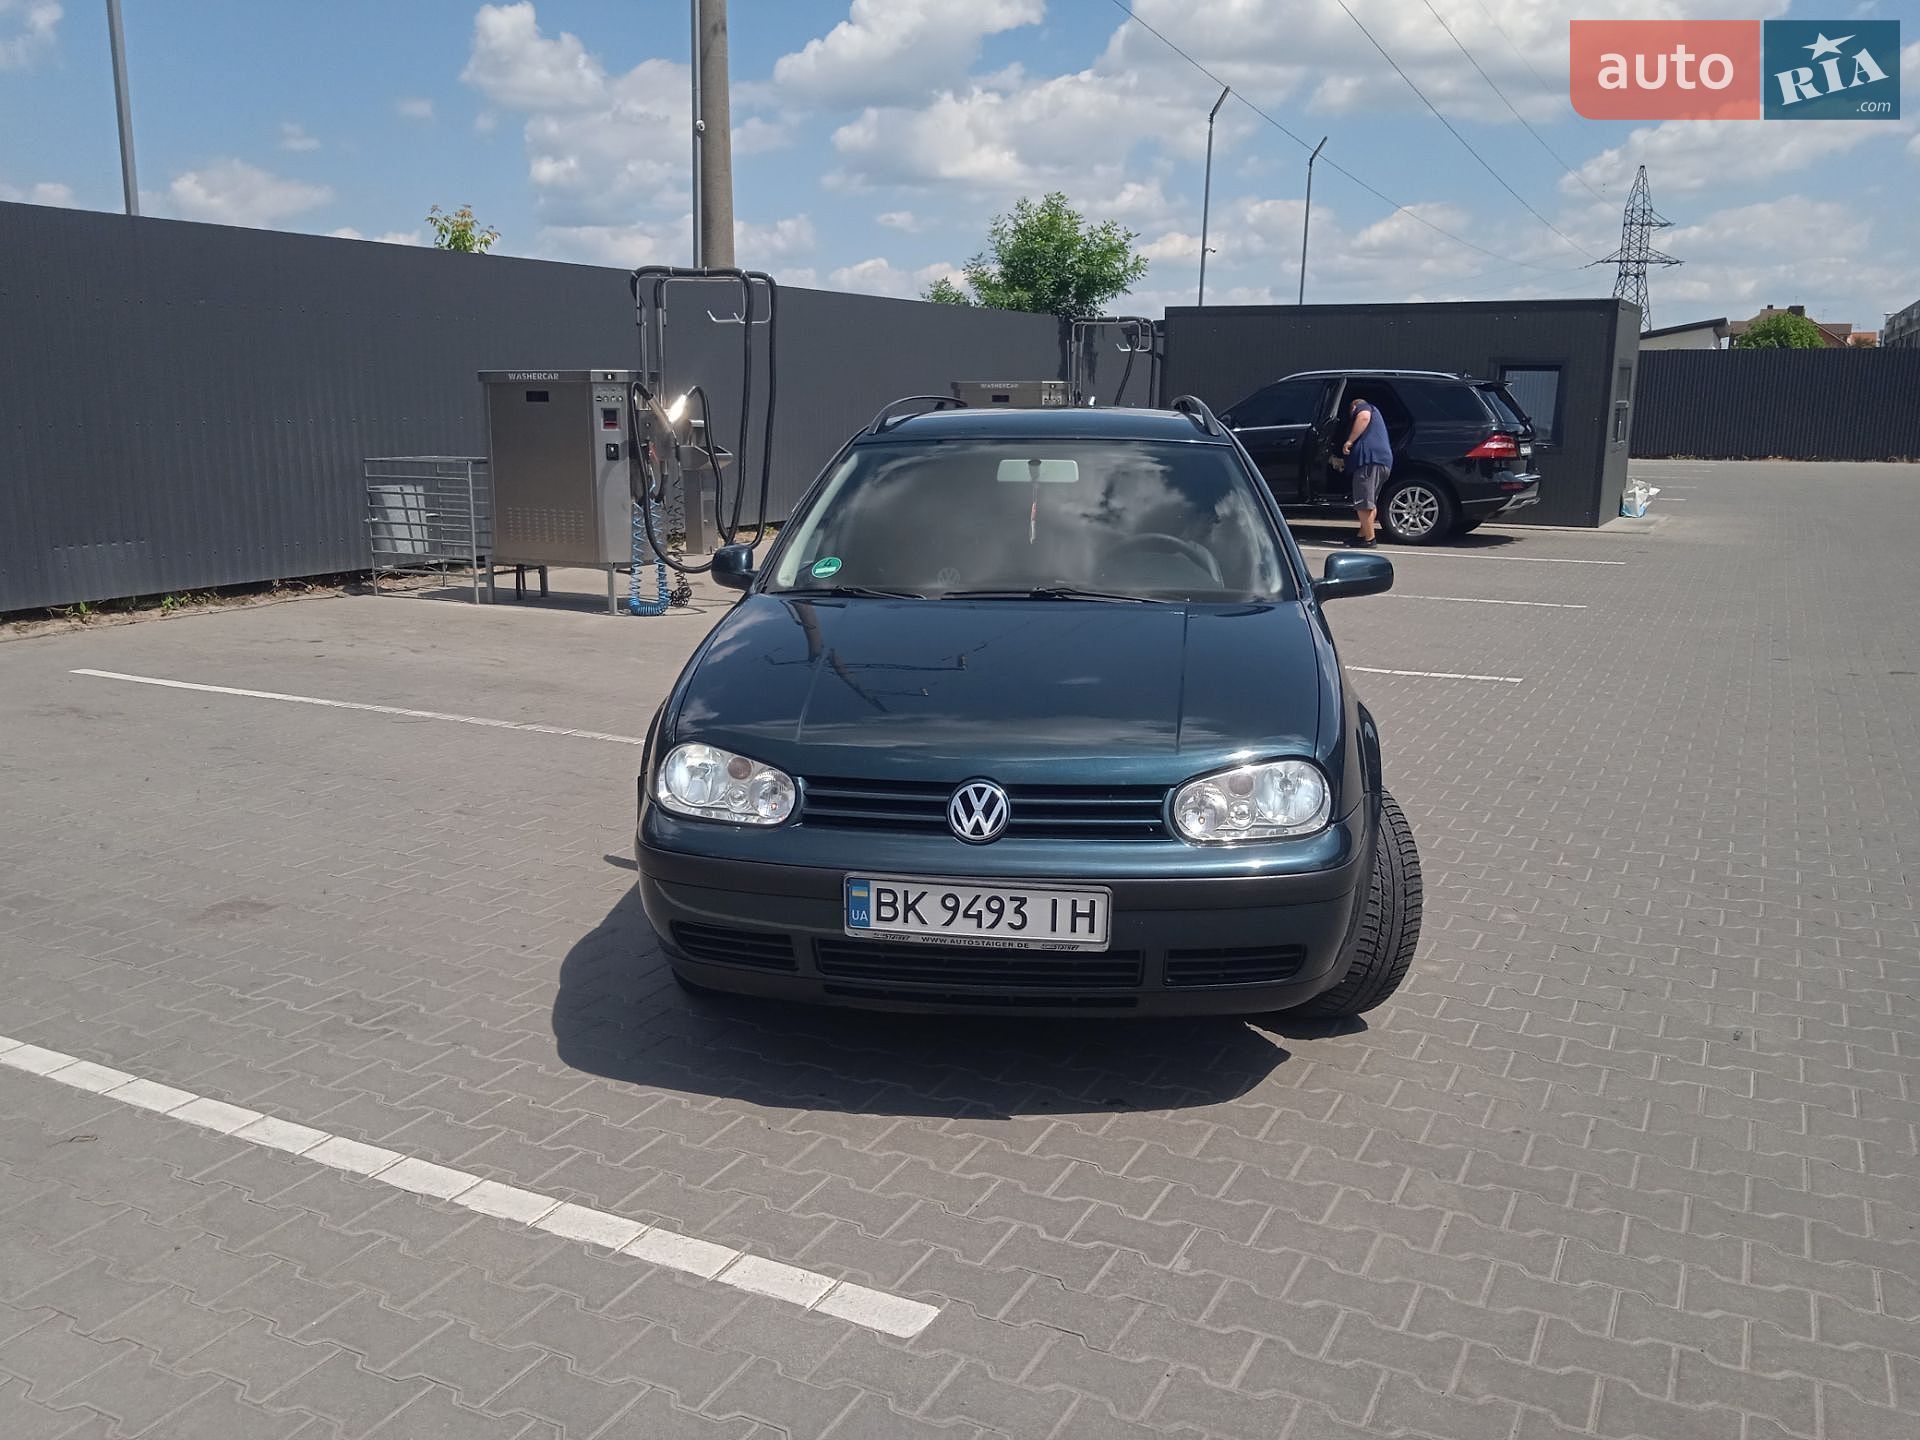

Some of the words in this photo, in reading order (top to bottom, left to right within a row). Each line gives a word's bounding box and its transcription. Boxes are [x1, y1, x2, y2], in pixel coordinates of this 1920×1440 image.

[508, 373, 559, 381] WASHERCAR
[852, 909, 868, 921] UA
[876, 887, 928, 925] BK
[940, 893, 1028, 931] 9493
[1050, 898, 1096, 934] IH
